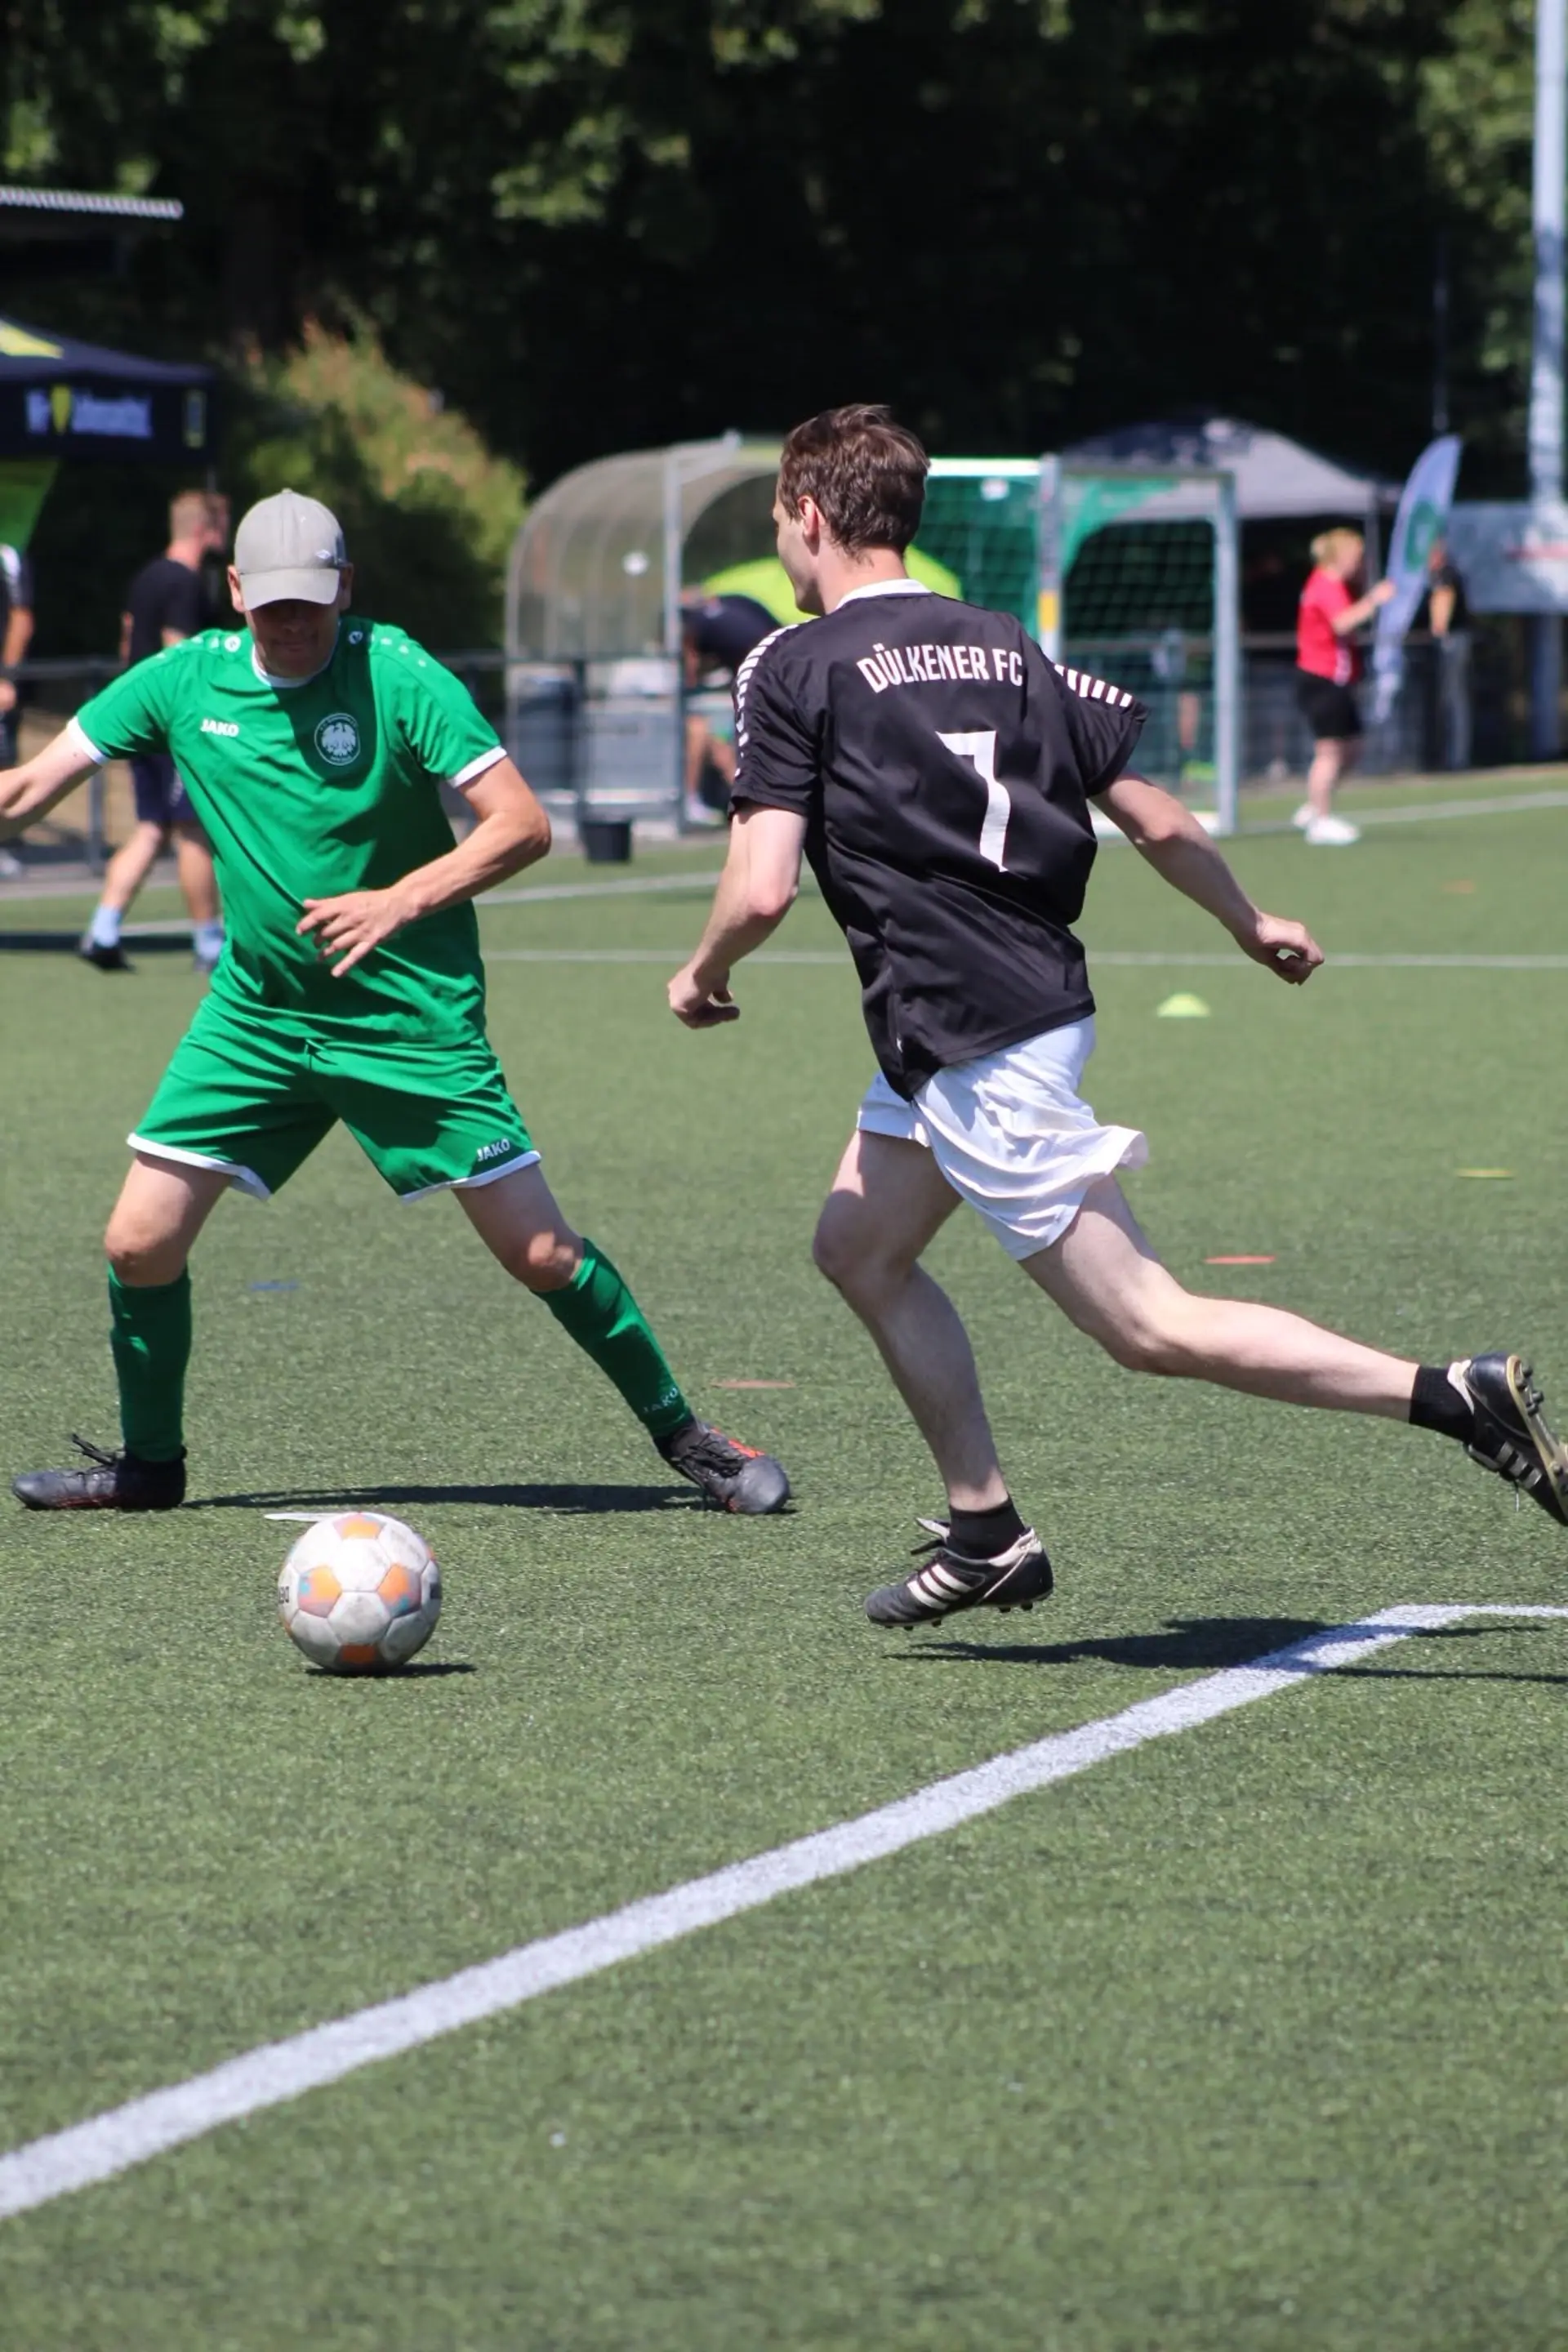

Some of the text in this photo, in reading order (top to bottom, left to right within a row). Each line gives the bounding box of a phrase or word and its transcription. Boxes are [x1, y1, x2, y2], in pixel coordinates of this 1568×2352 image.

[857, 643, 1023, 694] DÜLKENER FC
[200, 718, 239, 737] JAKO
[935, 730, 1010, 872] 7
[477, 1138, 510, 1162] JAKO
